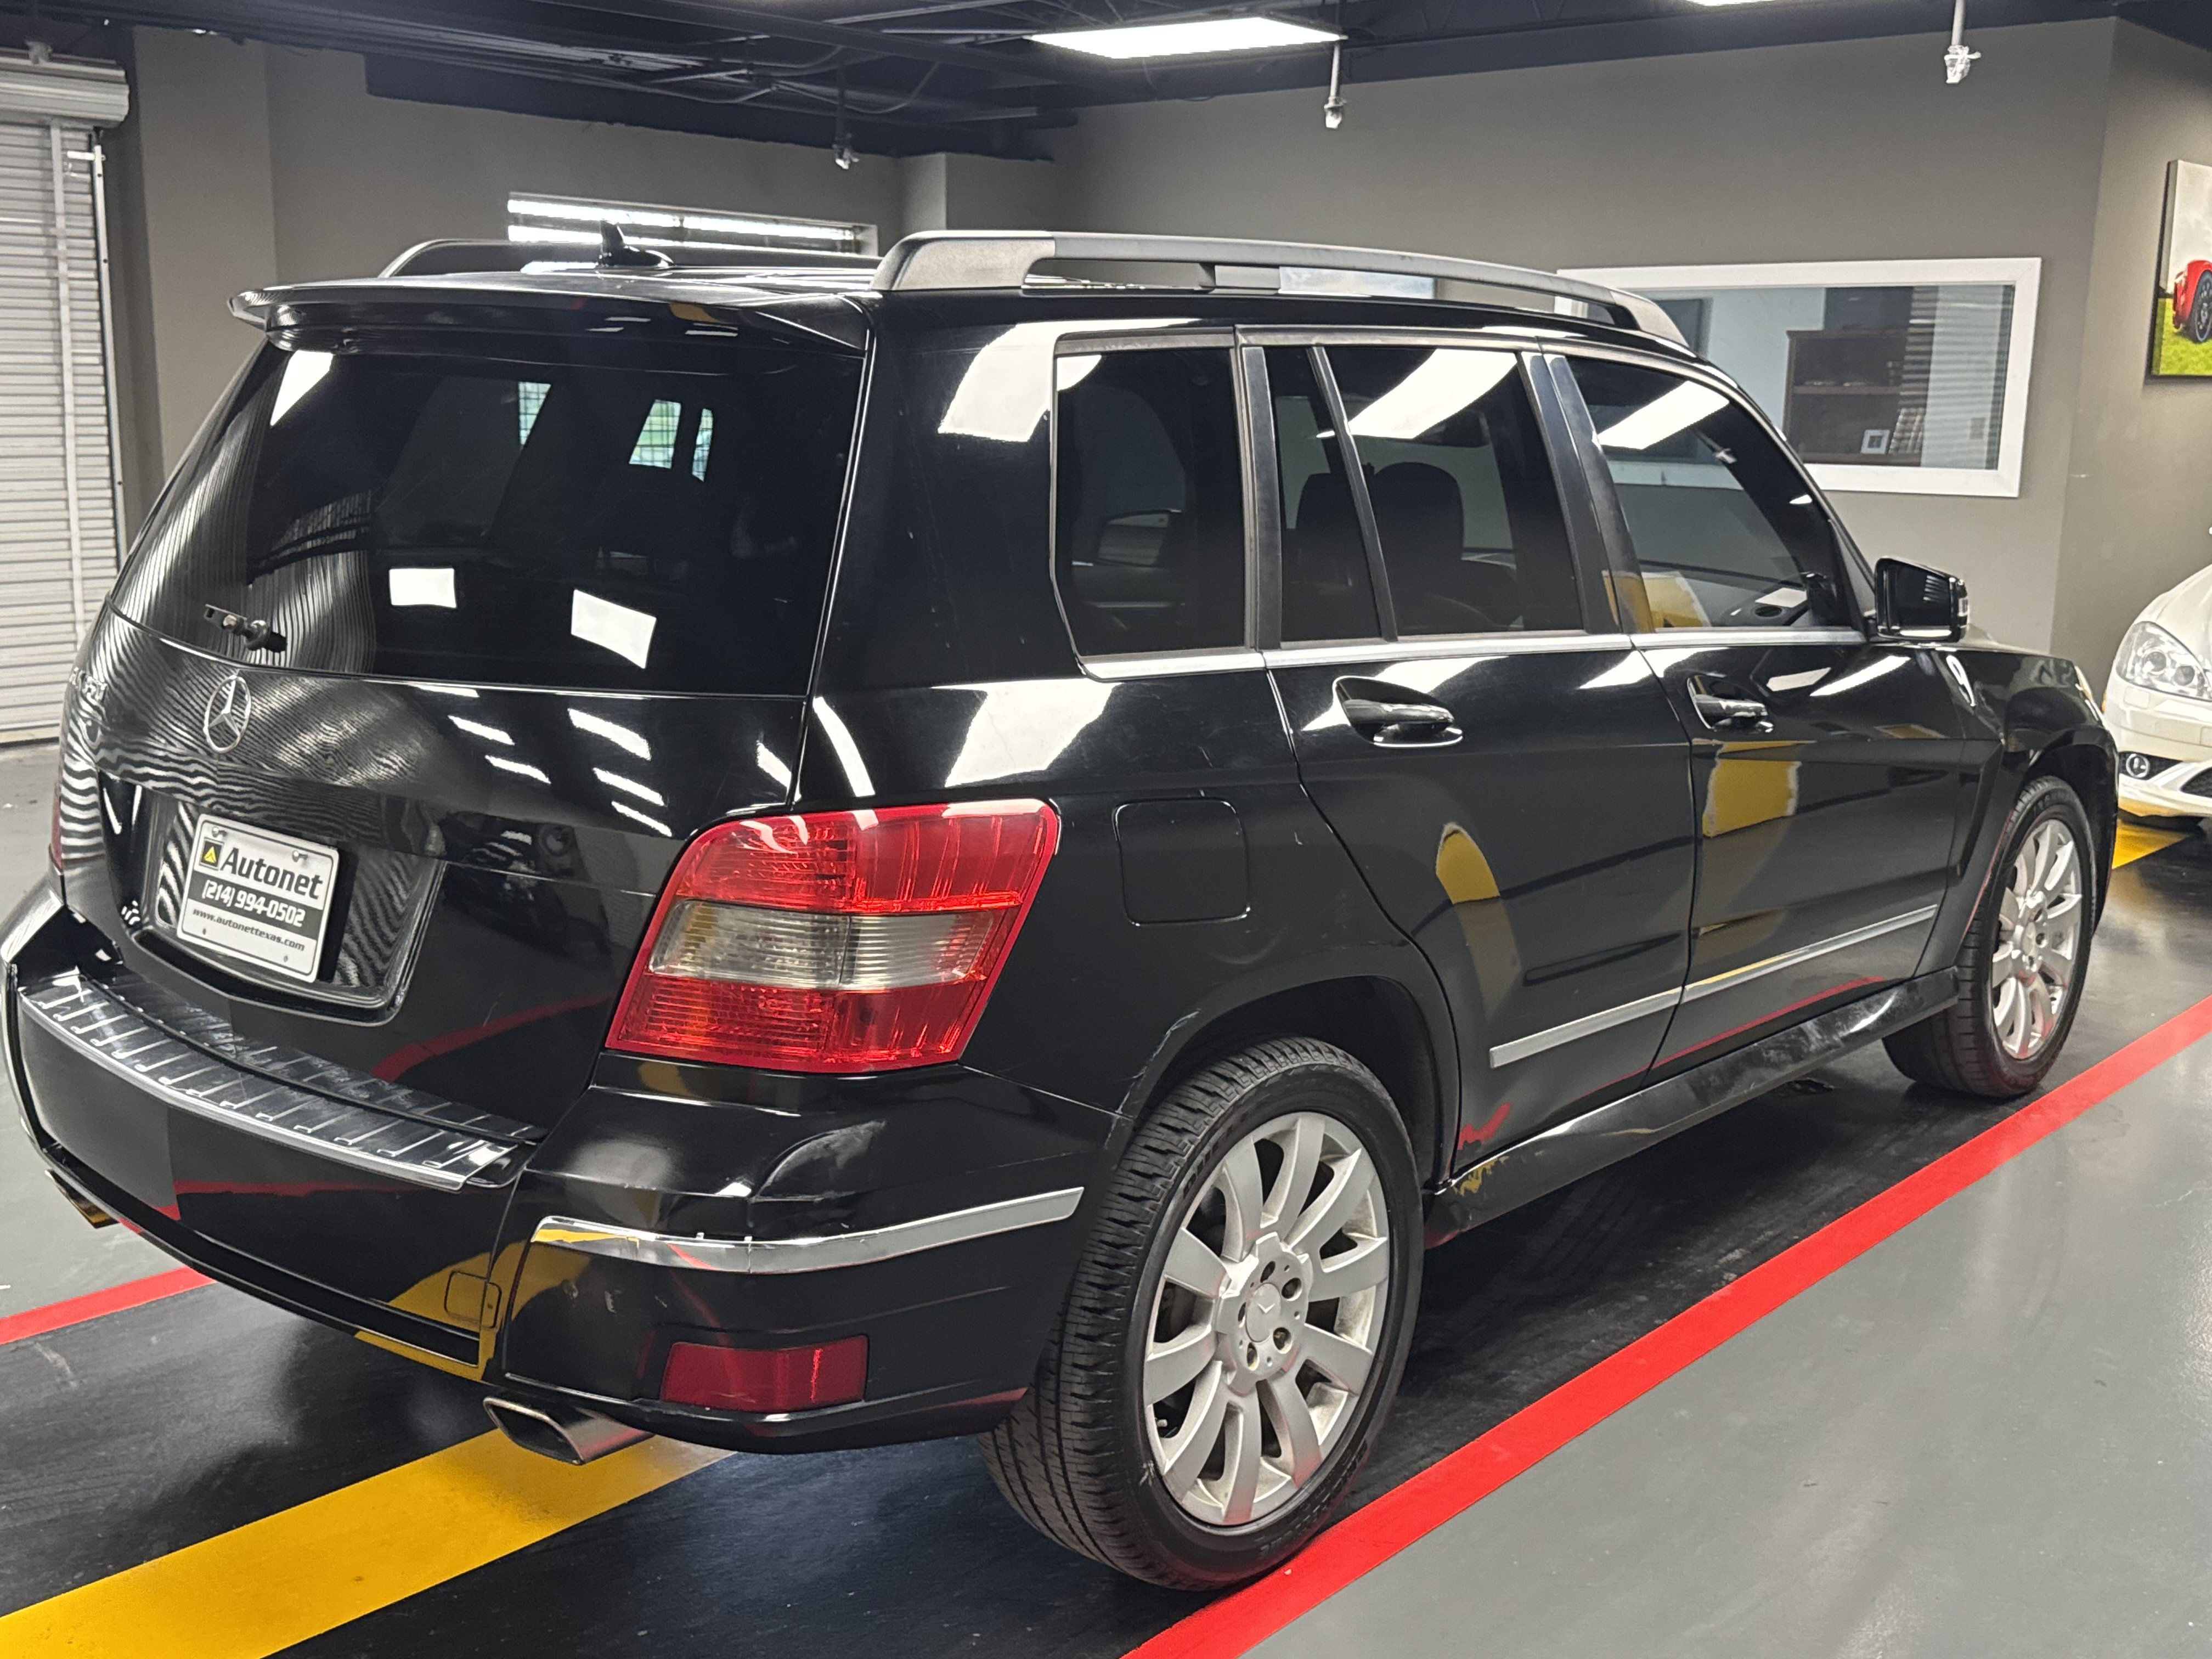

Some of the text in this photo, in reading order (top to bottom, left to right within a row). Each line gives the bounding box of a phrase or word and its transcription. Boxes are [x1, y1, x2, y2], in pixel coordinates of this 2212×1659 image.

[221, 847, 324, 900] Autonet
[202, 879, 306, 927] (214) 994-0502
[193, 908, 306, 951] www.autonettexas.com
